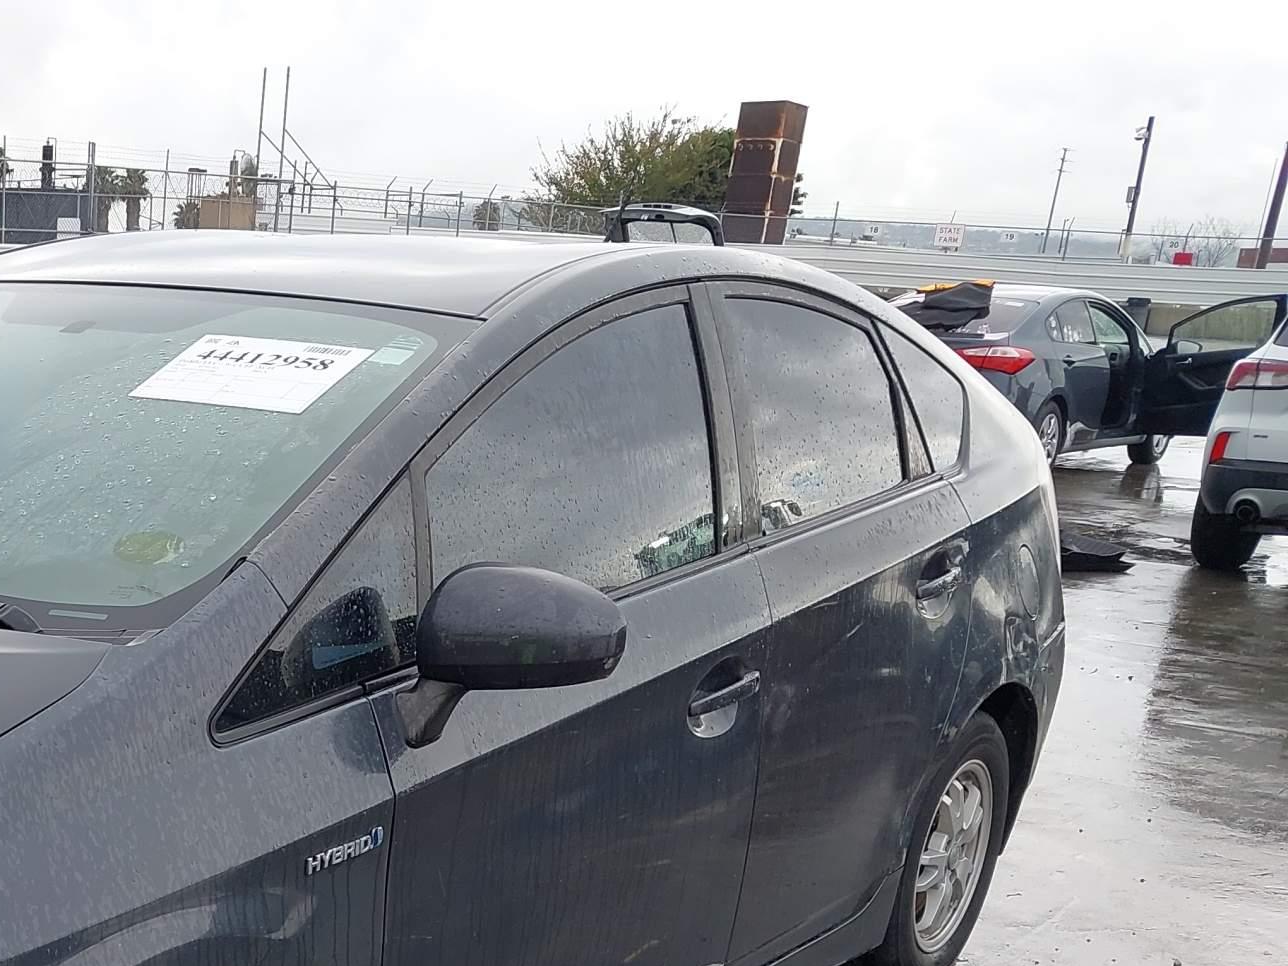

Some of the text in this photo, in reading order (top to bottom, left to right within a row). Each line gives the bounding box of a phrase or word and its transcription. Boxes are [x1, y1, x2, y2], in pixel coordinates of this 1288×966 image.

[1005, 233, 1015, 241] 19
[196, 349, 334, 370] 44412958
[306, 835, 373, 875] HYBRID
